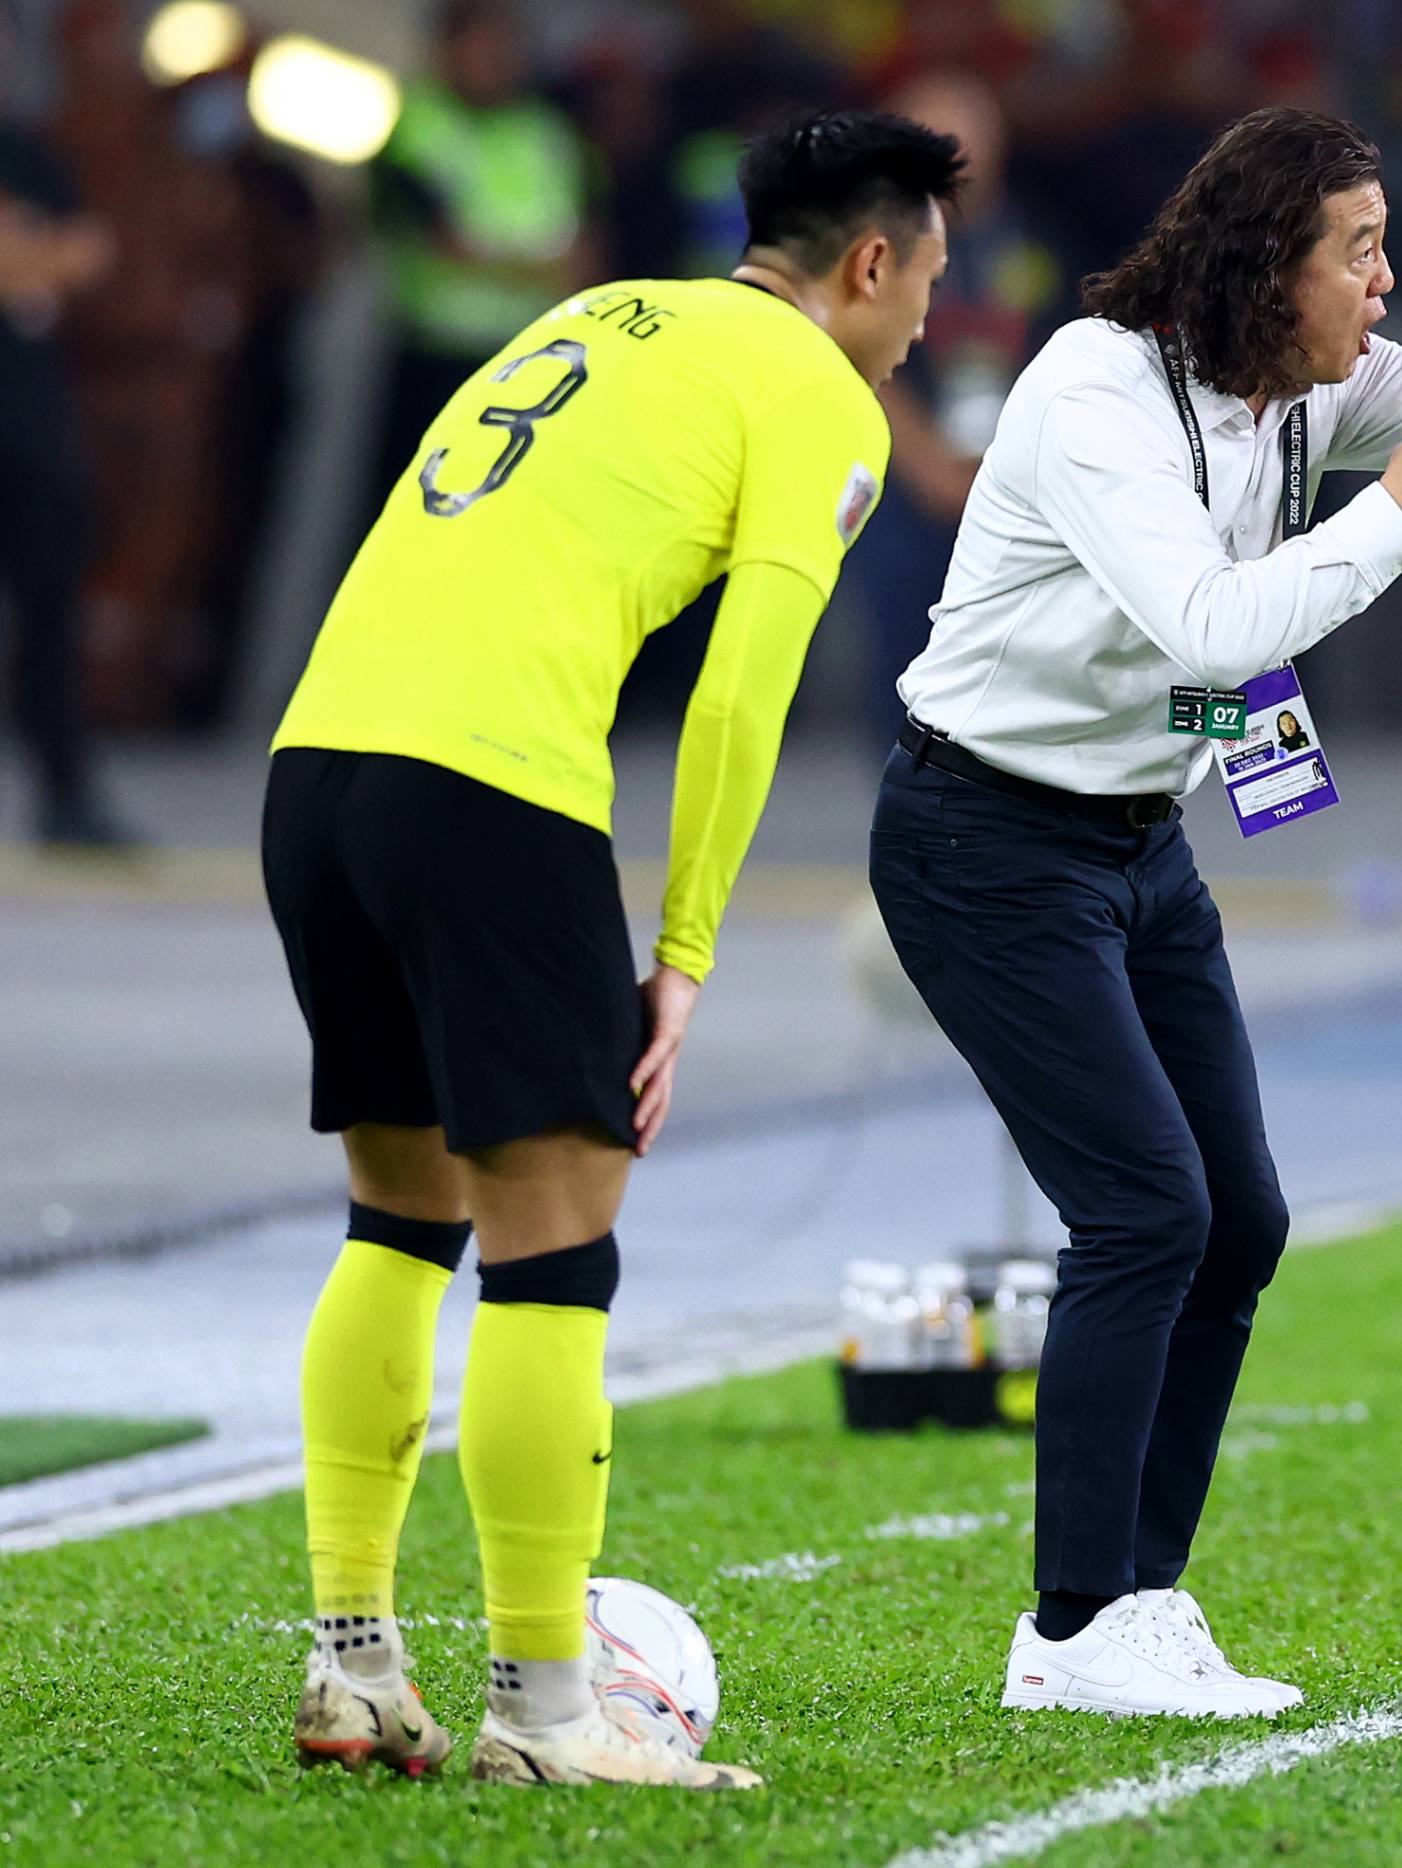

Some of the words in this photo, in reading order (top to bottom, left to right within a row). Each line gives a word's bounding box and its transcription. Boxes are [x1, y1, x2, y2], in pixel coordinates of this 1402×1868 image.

[419, 338, 588, 518] 3
[1291, 421, 1302, 473] ELECTRIC
[1191, 440, 1204, 491] ELECTRIC
[1290, 473, 1301, 498] CUP
[1289, 499, 1300, 525] 2022
[1195, 704, 1202, 716] 1
[1213, 706, 1239, 724] 07
[1193, 719, 1202, 731] 2
[1211, 723, 1239, 731] JANUARY
[1225, 753, 1244, 764] FINAL
[1273, 801, 1304, 819] TEAM
